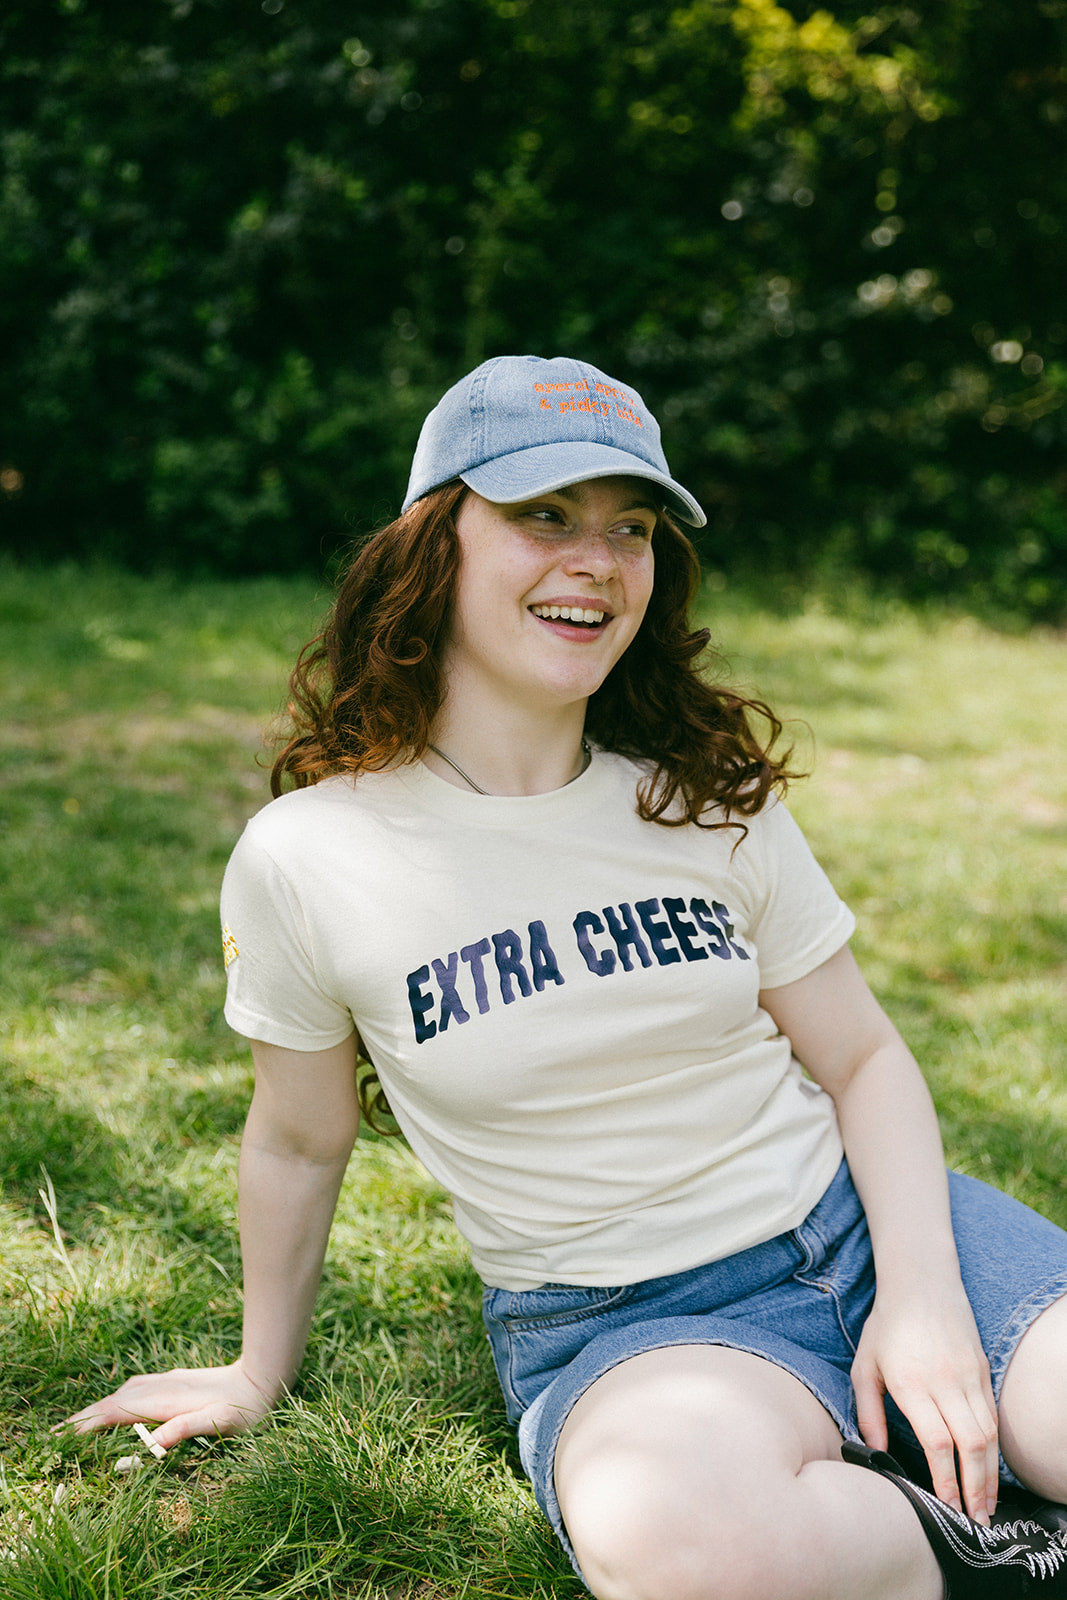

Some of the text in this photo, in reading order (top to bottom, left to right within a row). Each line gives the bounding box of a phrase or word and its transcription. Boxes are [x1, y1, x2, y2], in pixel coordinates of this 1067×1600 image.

[534, 378, 590, 393] aperol
[539, 396, 643, 429] & picky bits
[406, 896, 752, 1045] EXTRA CHEESE
